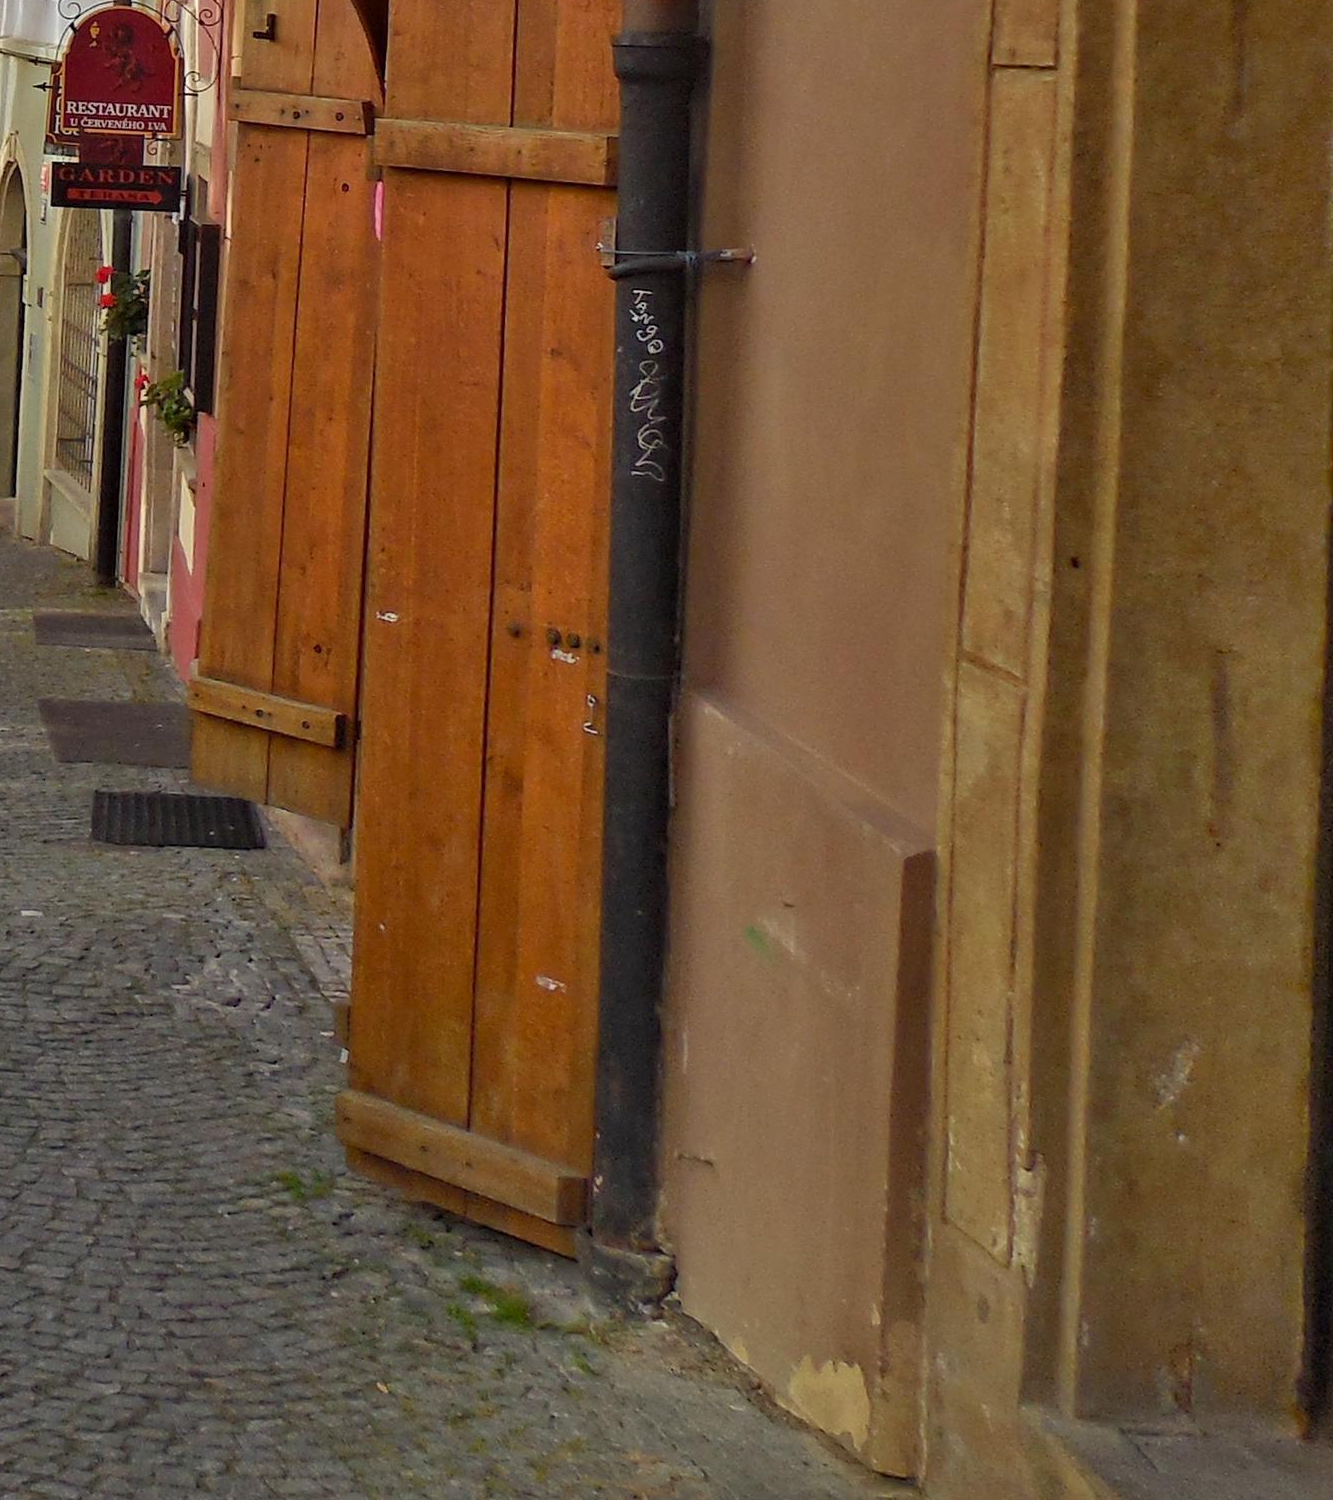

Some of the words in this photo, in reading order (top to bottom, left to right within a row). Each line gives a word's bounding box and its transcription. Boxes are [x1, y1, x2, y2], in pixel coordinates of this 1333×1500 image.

[65, 100, 173, 119] RESTAURANT
[70, 118, 79, 128] U
[80, 116, 146, 131] ČERVENÉHO
[148, 121, 168, 131] LVA
[58, 166, 175, 185] GARDEN
